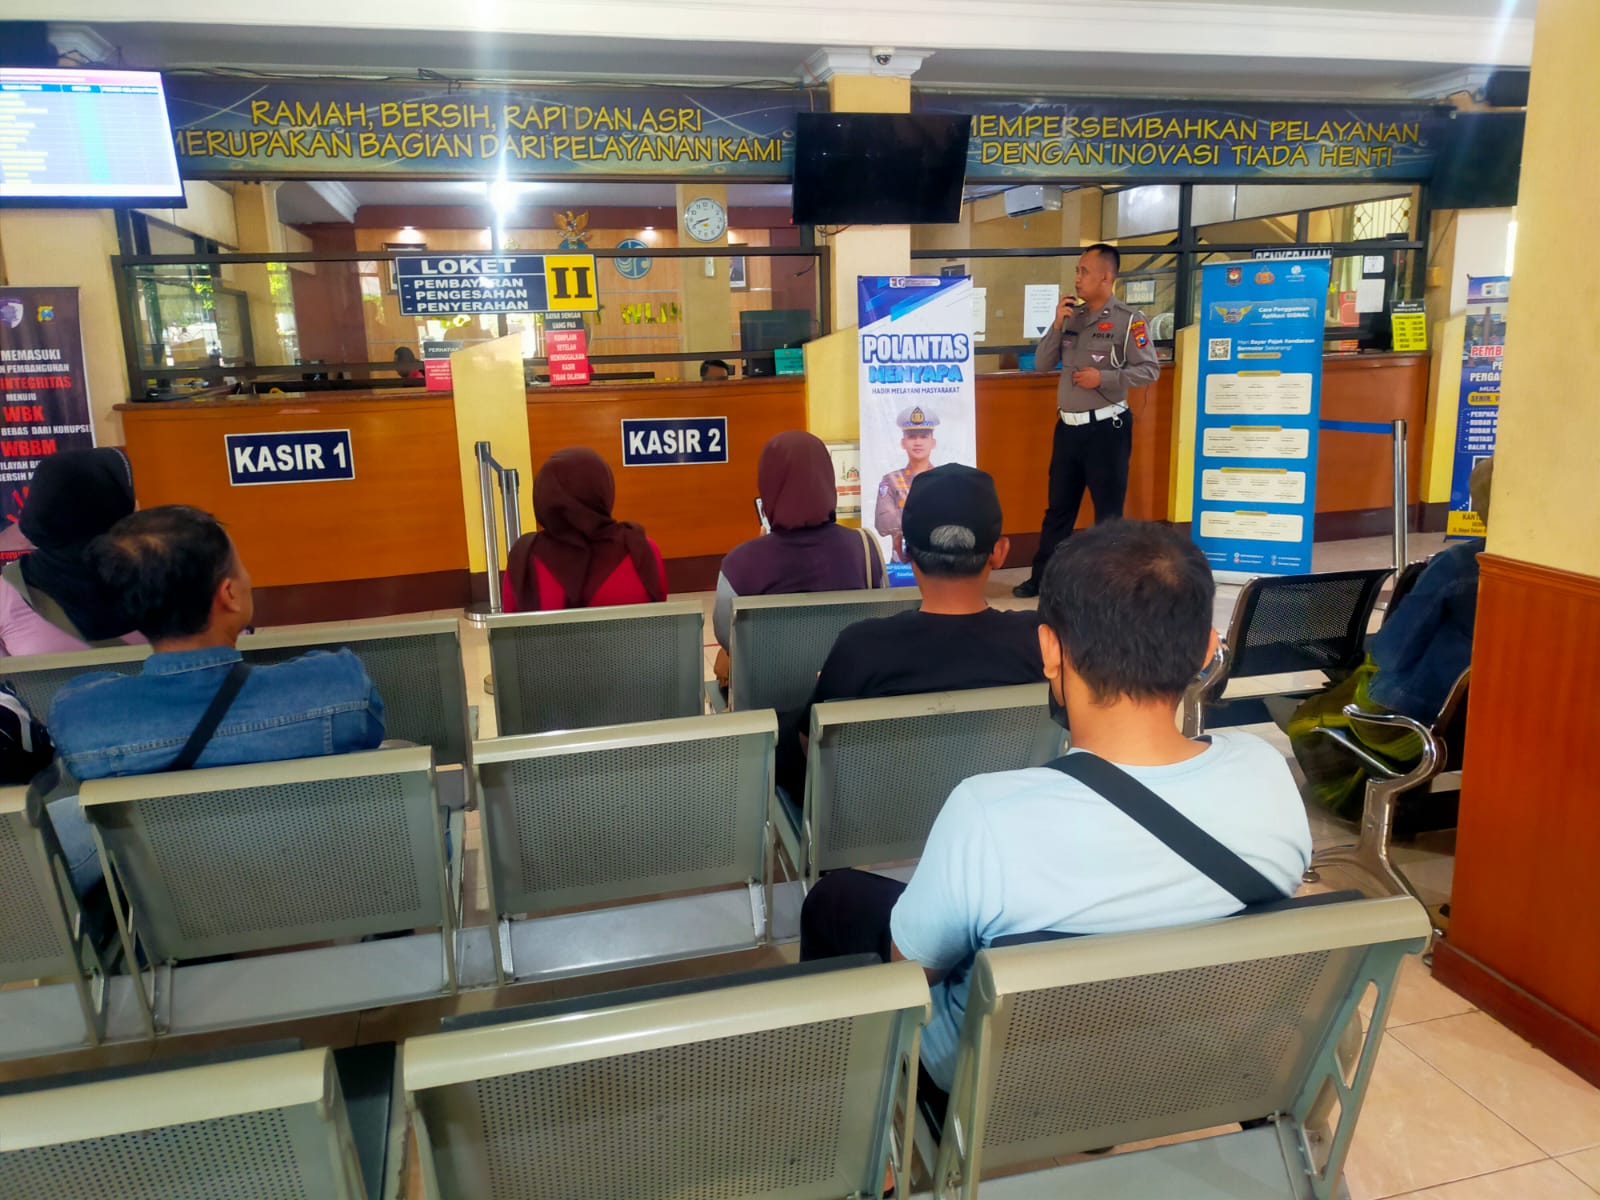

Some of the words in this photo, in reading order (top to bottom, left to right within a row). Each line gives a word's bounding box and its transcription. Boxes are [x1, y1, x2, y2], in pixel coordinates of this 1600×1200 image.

[251, 100, 374, 130] RAMAH,
[381, 103, 496, 132] BERSIH,
[504, 105, 568, 131] RAPI
[574, 106, 634, 132] DAN
[638, 108, 702, 132] ASRI
[1269, 120, 1420, 144] PELAYANAN
[359, 132, 474, 159] BAGIAN
[480, 134, 547, 159] DARI
[553, 135, 712, 161] PELAYANAN
[718, 137, 783, 162] KAMI
[981, 141, 1104, 165] DENGAN
[1110, 143, 1219, 166] INOVASI
[1231, 145, 1310, 166] TIADA
[1318, 147, 1393, 167] HENTI
[420, 258, 517, 275] LOKET
[551, 266, 592, 299] II
[415, 289, 528, 301] PENGESAHAN
[417, 300, 529, 312] PENYERAHAN
[0, 349, 61, 361] MEMASUKI
[862, 333, 969, 363] POLANTAS
[868, 364, 963, 384] MENYAPA
[2, 405, 45, 423] WBK
[1, 438, 57, 457] WBBM
[629, 430, 700, 456] KASIR
[706, 428, 721, 453] 2
[233, 444, 322, 474] KASIR
[332, 441, 346, 469] 1
